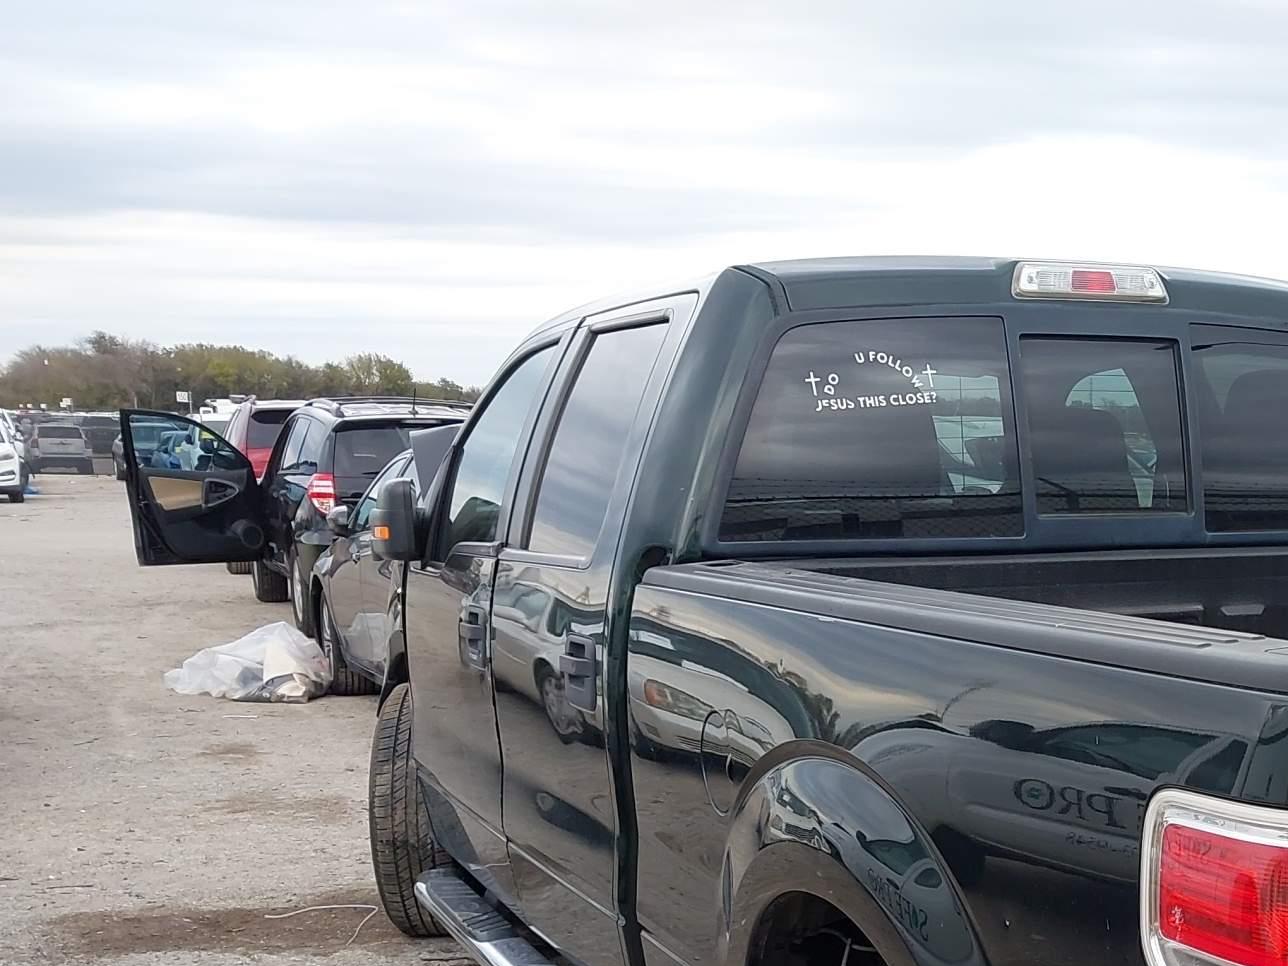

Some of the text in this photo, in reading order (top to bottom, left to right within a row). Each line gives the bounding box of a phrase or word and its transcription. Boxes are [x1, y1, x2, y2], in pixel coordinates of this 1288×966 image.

[823, 351, 924, 396] DO U FOLLOW
[857, 395, 887, 408] THIS
[889, 391, 937, 406] CLOSE?
